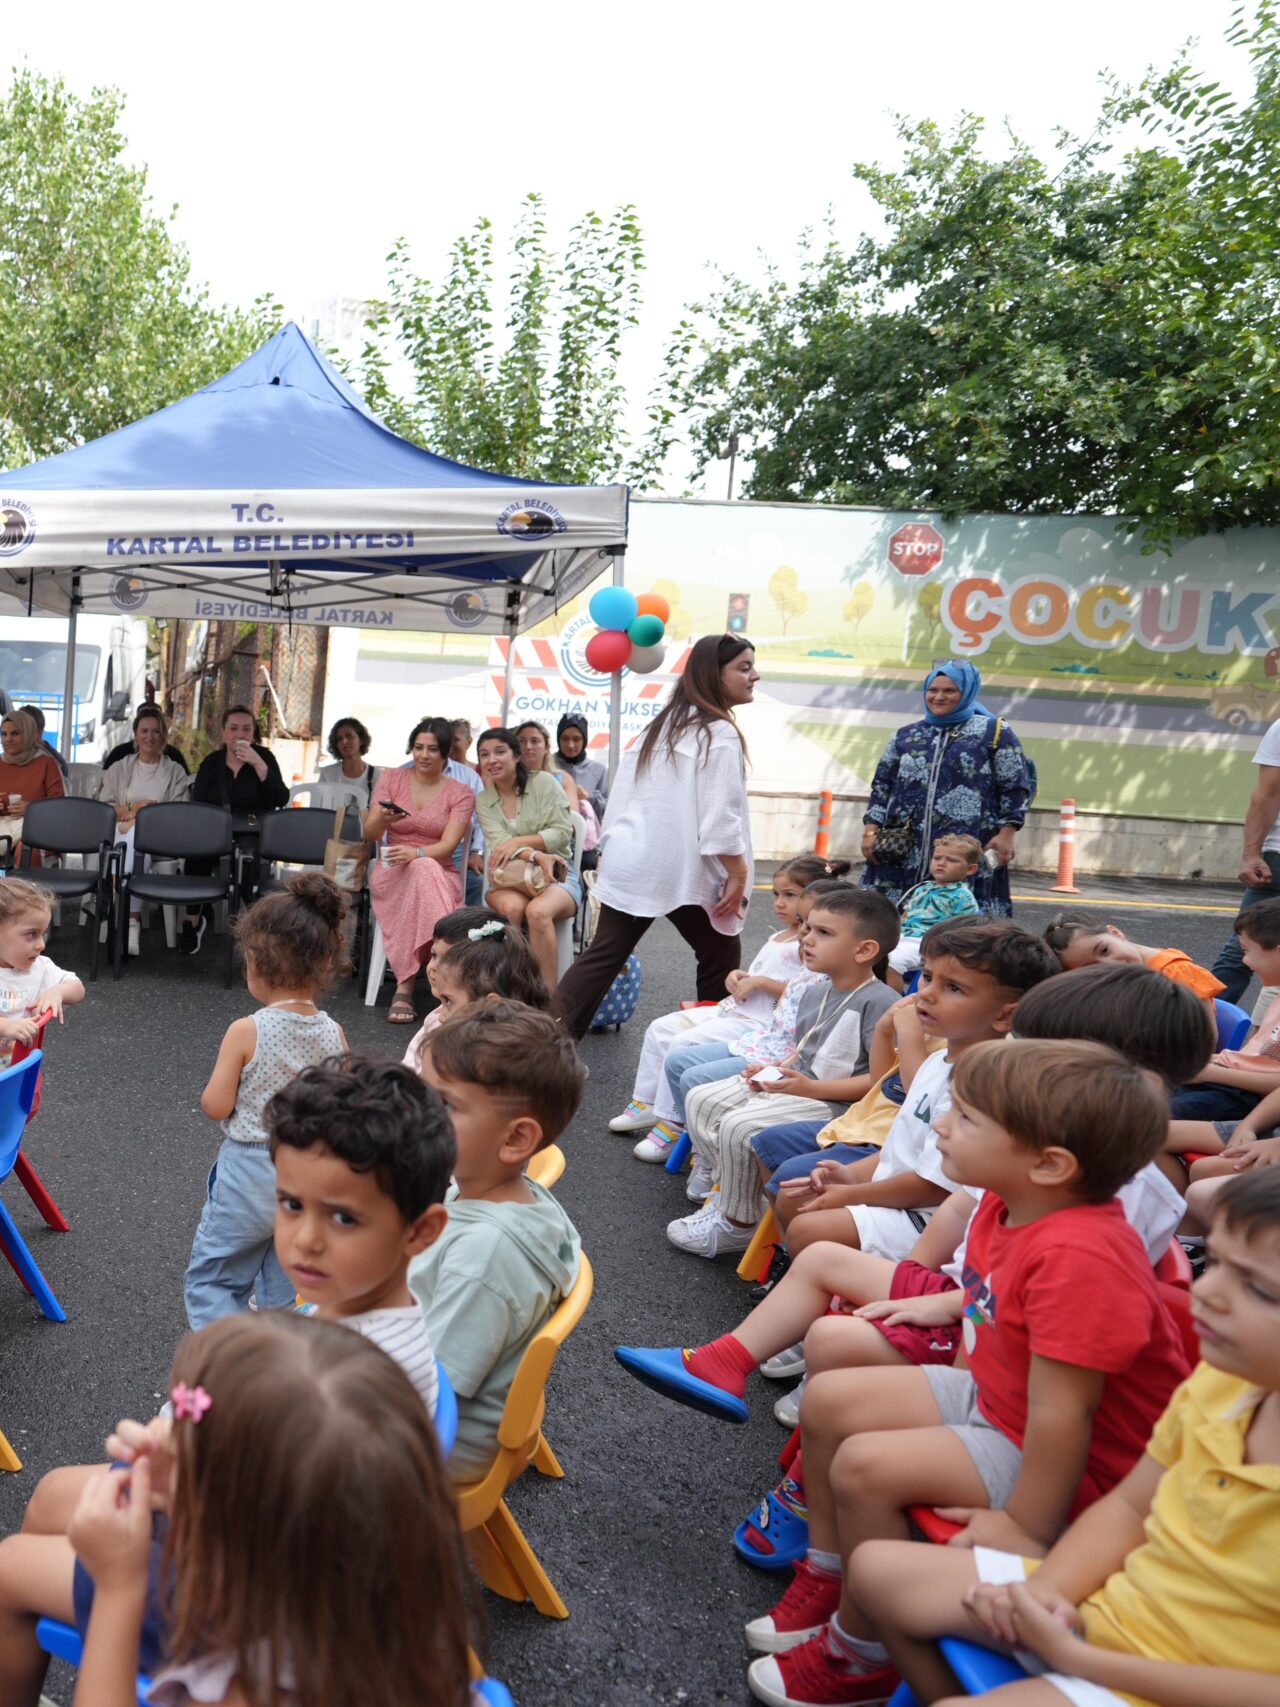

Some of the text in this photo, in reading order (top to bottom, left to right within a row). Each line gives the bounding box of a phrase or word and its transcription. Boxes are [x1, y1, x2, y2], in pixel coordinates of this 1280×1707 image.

[231, 503, 284, 523] T.C.
[106, 531, 415, 556] KARTAL BELEDİYESİ
[893, 541, 938, 556] STOP
[948, 577, 1278, 649] ÇOCUK
[561, 615, 592, 647] KARTAL
[515, 693, 662, 716] GÖKHAN YÜKSE
